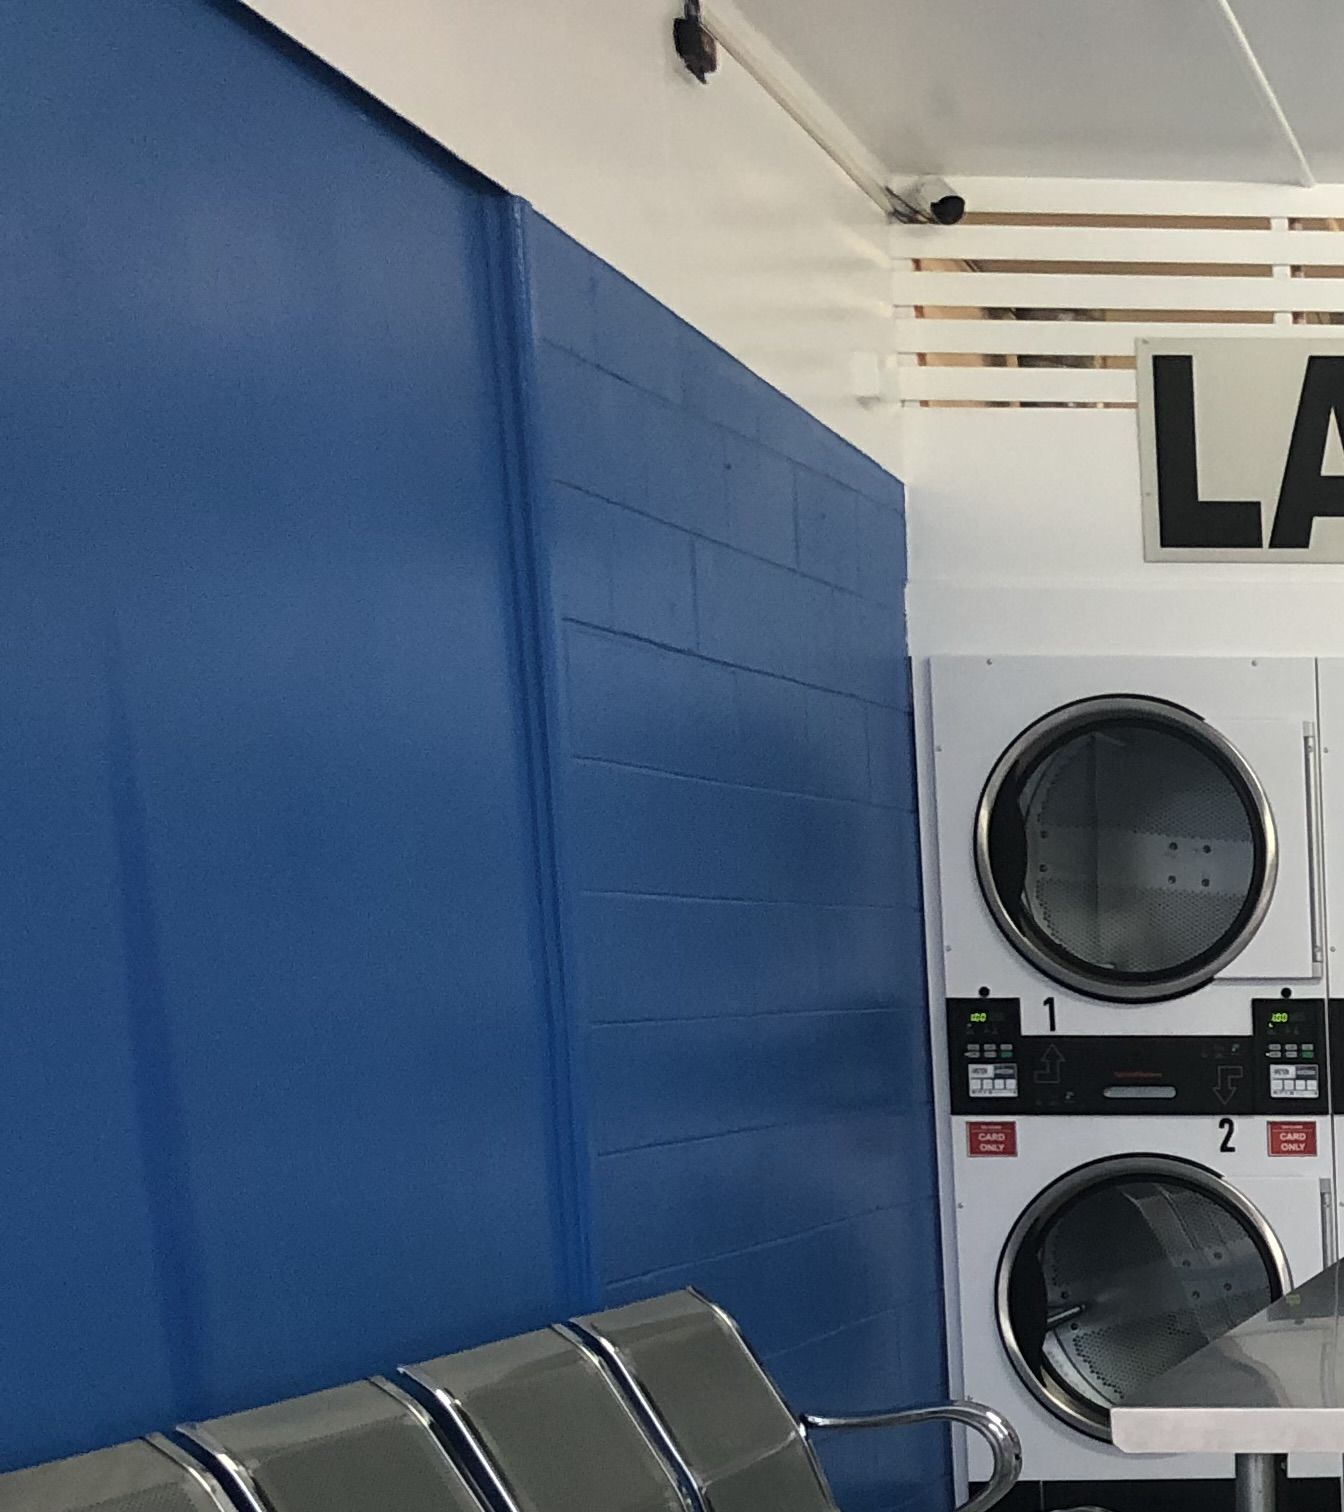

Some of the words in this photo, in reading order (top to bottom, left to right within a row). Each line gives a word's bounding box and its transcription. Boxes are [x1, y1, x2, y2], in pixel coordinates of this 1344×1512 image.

[1043, 996, 1056, 1032] 1
[978, 1132, 1006, 1141] CARD
[1218, 1117, 1236, 1153] 2
[1279, 1132, 1306, 1141] CARD
[979, 1143, 1006, 1152] ONLY
[1280, 1143, 1306, 1152] ONLY
